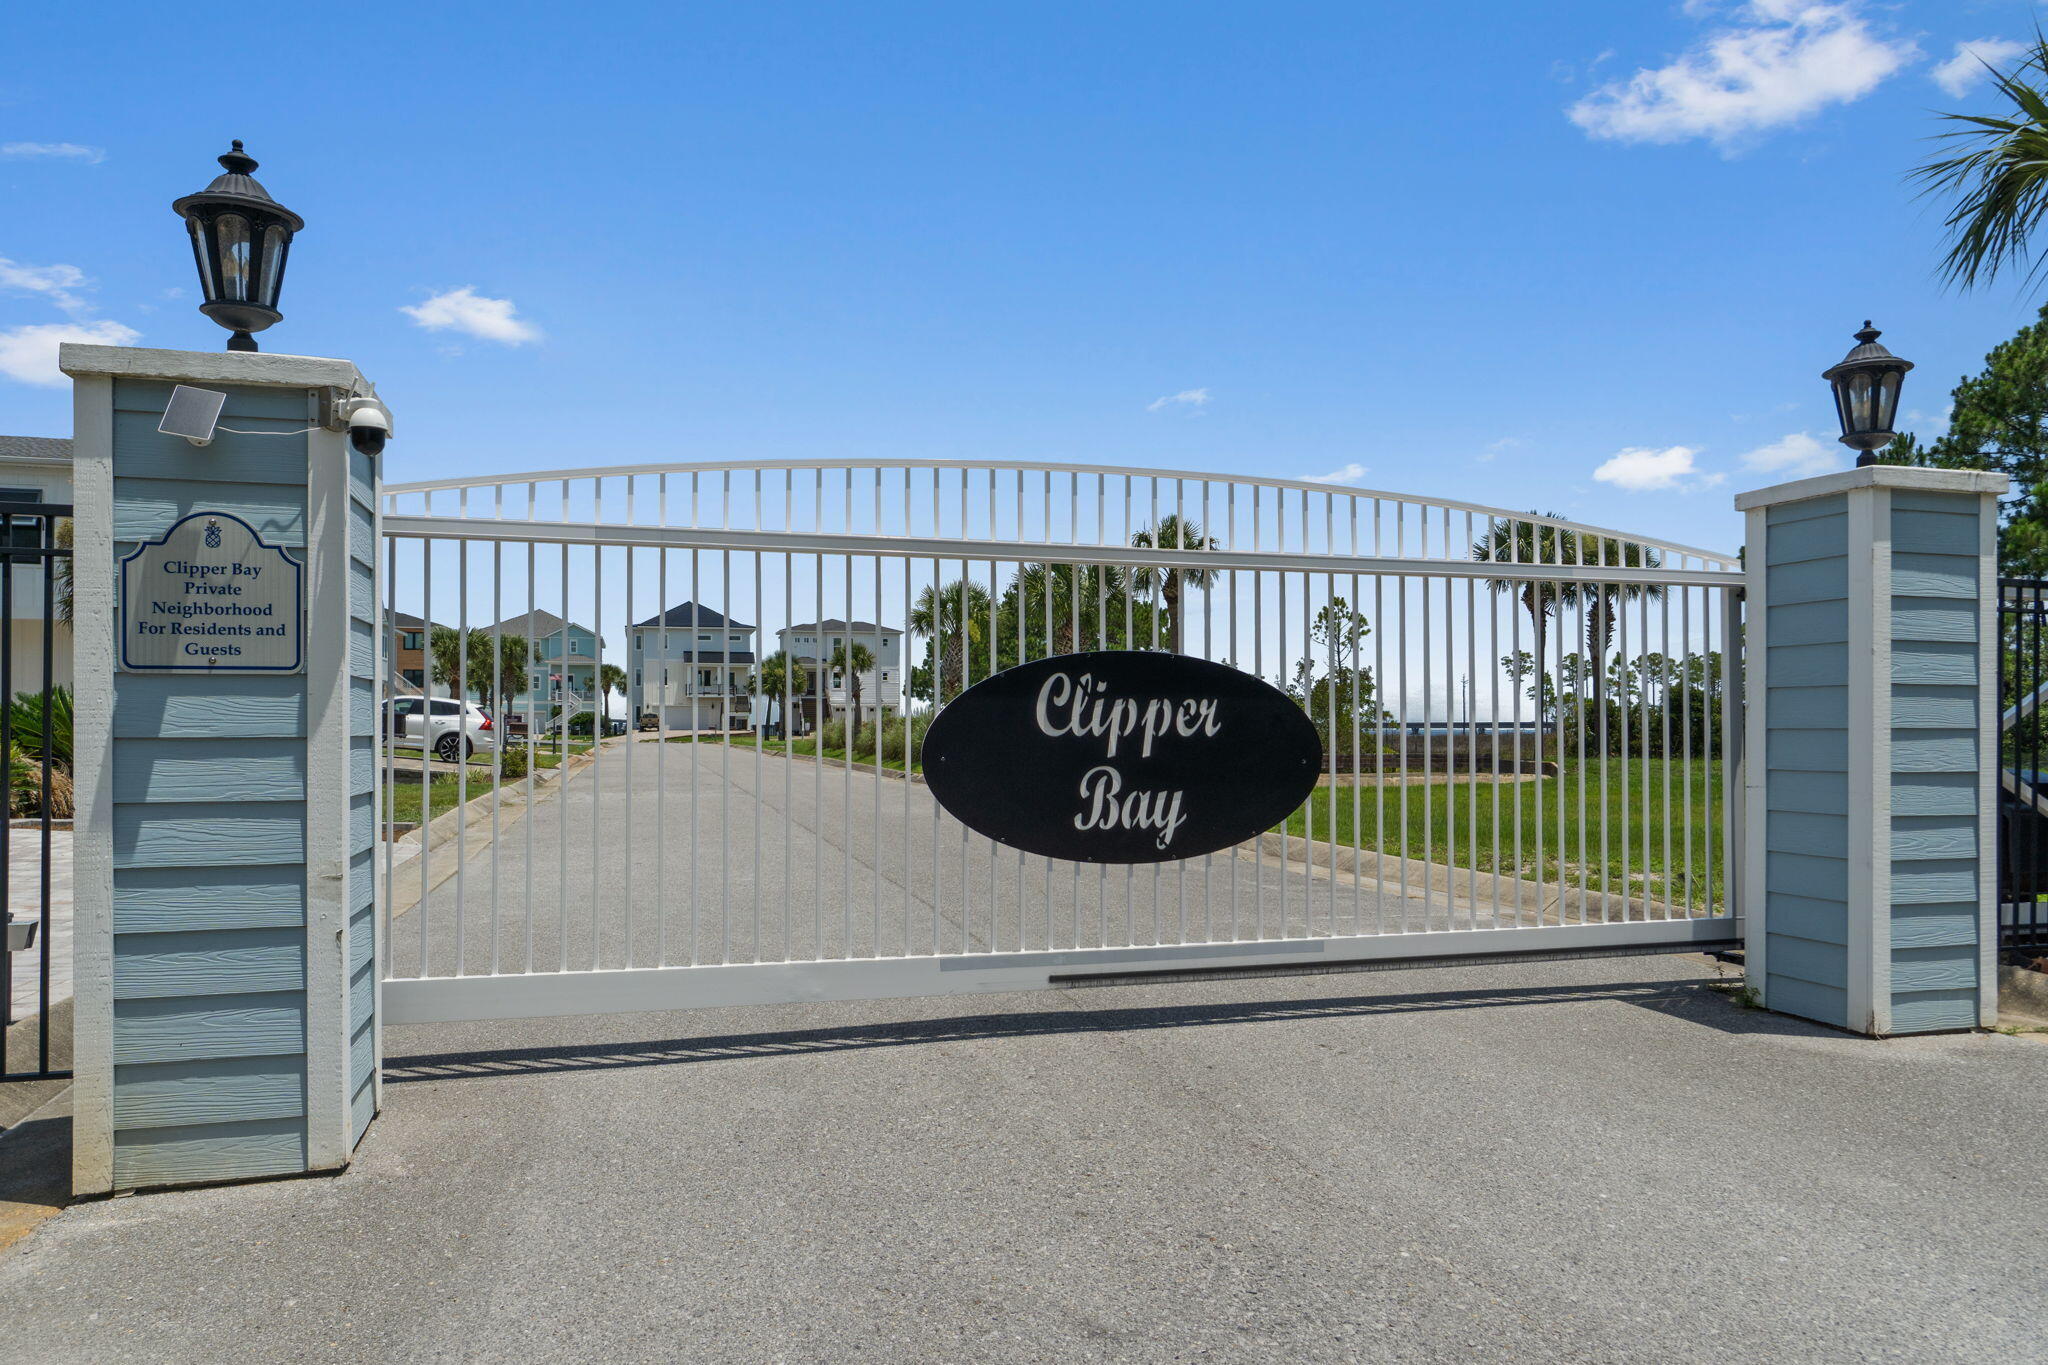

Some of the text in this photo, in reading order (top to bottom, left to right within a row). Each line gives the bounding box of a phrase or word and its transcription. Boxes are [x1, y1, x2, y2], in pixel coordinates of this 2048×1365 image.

[163, 561, 262, 579] Clipper Bay
[184, 582, 242, 595] Private
[152, 602, 273, 618] Neighborhood
[138, 622, 286, 636] For Residents and
[185, 643, 241, 655] Guests
[1036, 672, 1222, 758] Clipper
[1074, 765, 1187, 850] Bay
